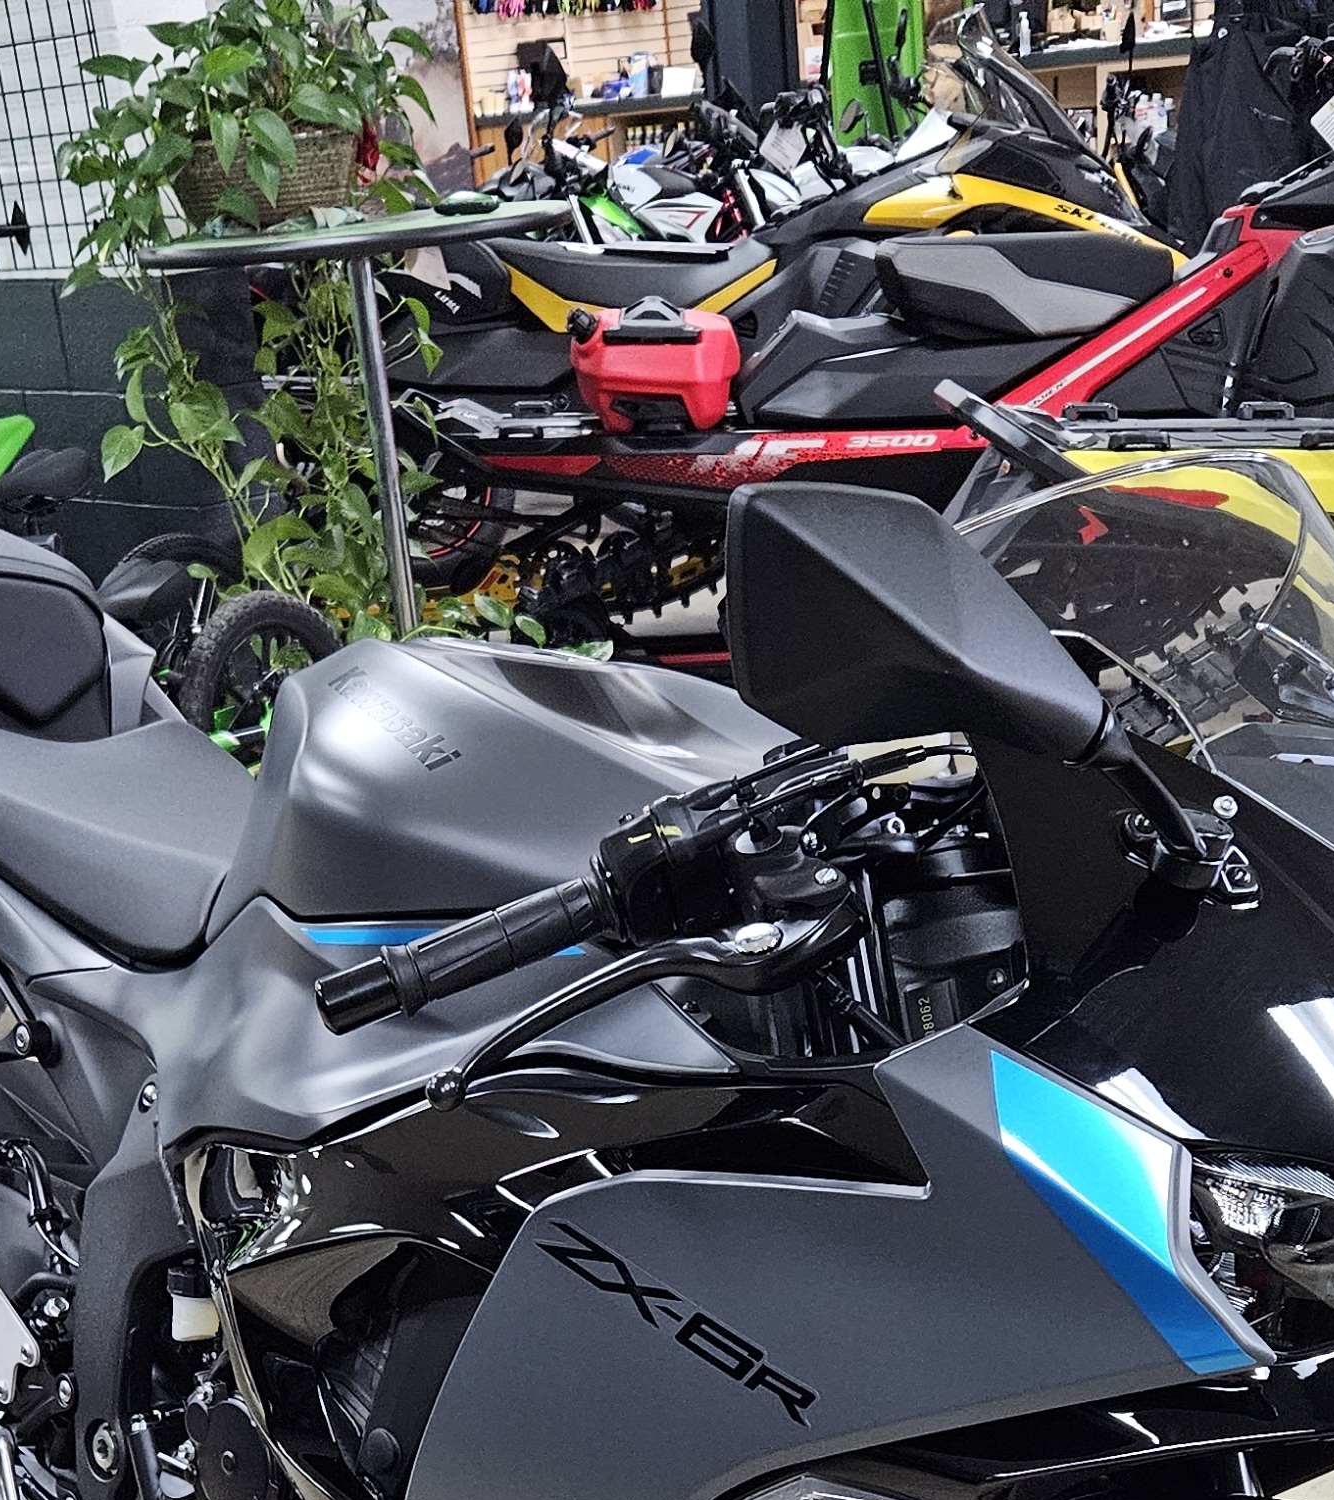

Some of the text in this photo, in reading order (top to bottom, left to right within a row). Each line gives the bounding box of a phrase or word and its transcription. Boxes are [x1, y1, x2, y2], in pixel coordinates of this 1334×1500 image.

[847, 434, 939, 449] 3500
[328, 666, 462, 771] Kawasaki
[534, 1218, 818, 1428] ZX-6R
